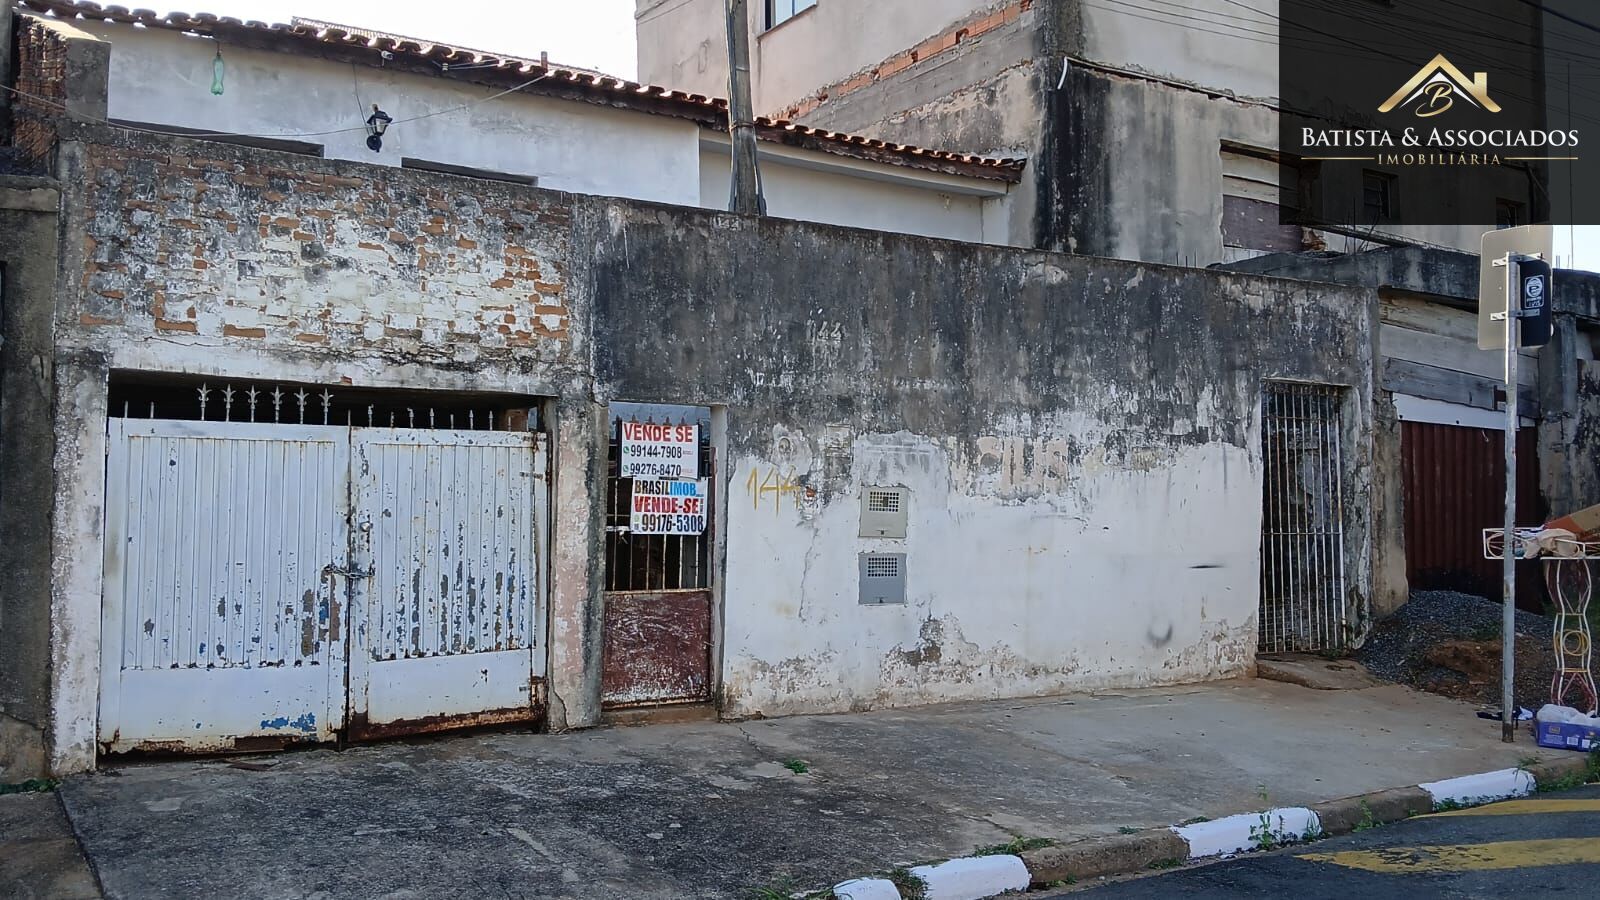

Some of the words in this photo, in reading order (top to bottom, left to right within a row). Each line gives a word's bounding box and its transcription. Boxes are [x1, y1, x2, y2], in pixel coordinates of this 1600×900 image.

[623, 423, 672, 442] VENDE
[675, 426, 694, 443] SE
[630, 444, 682, 459] 99144-7908
[629, 463, 682, 476] 99276-8470
[634, 496, 699, 515] VENDE-SE
[641, 514, 704, 533] 99176-5308
